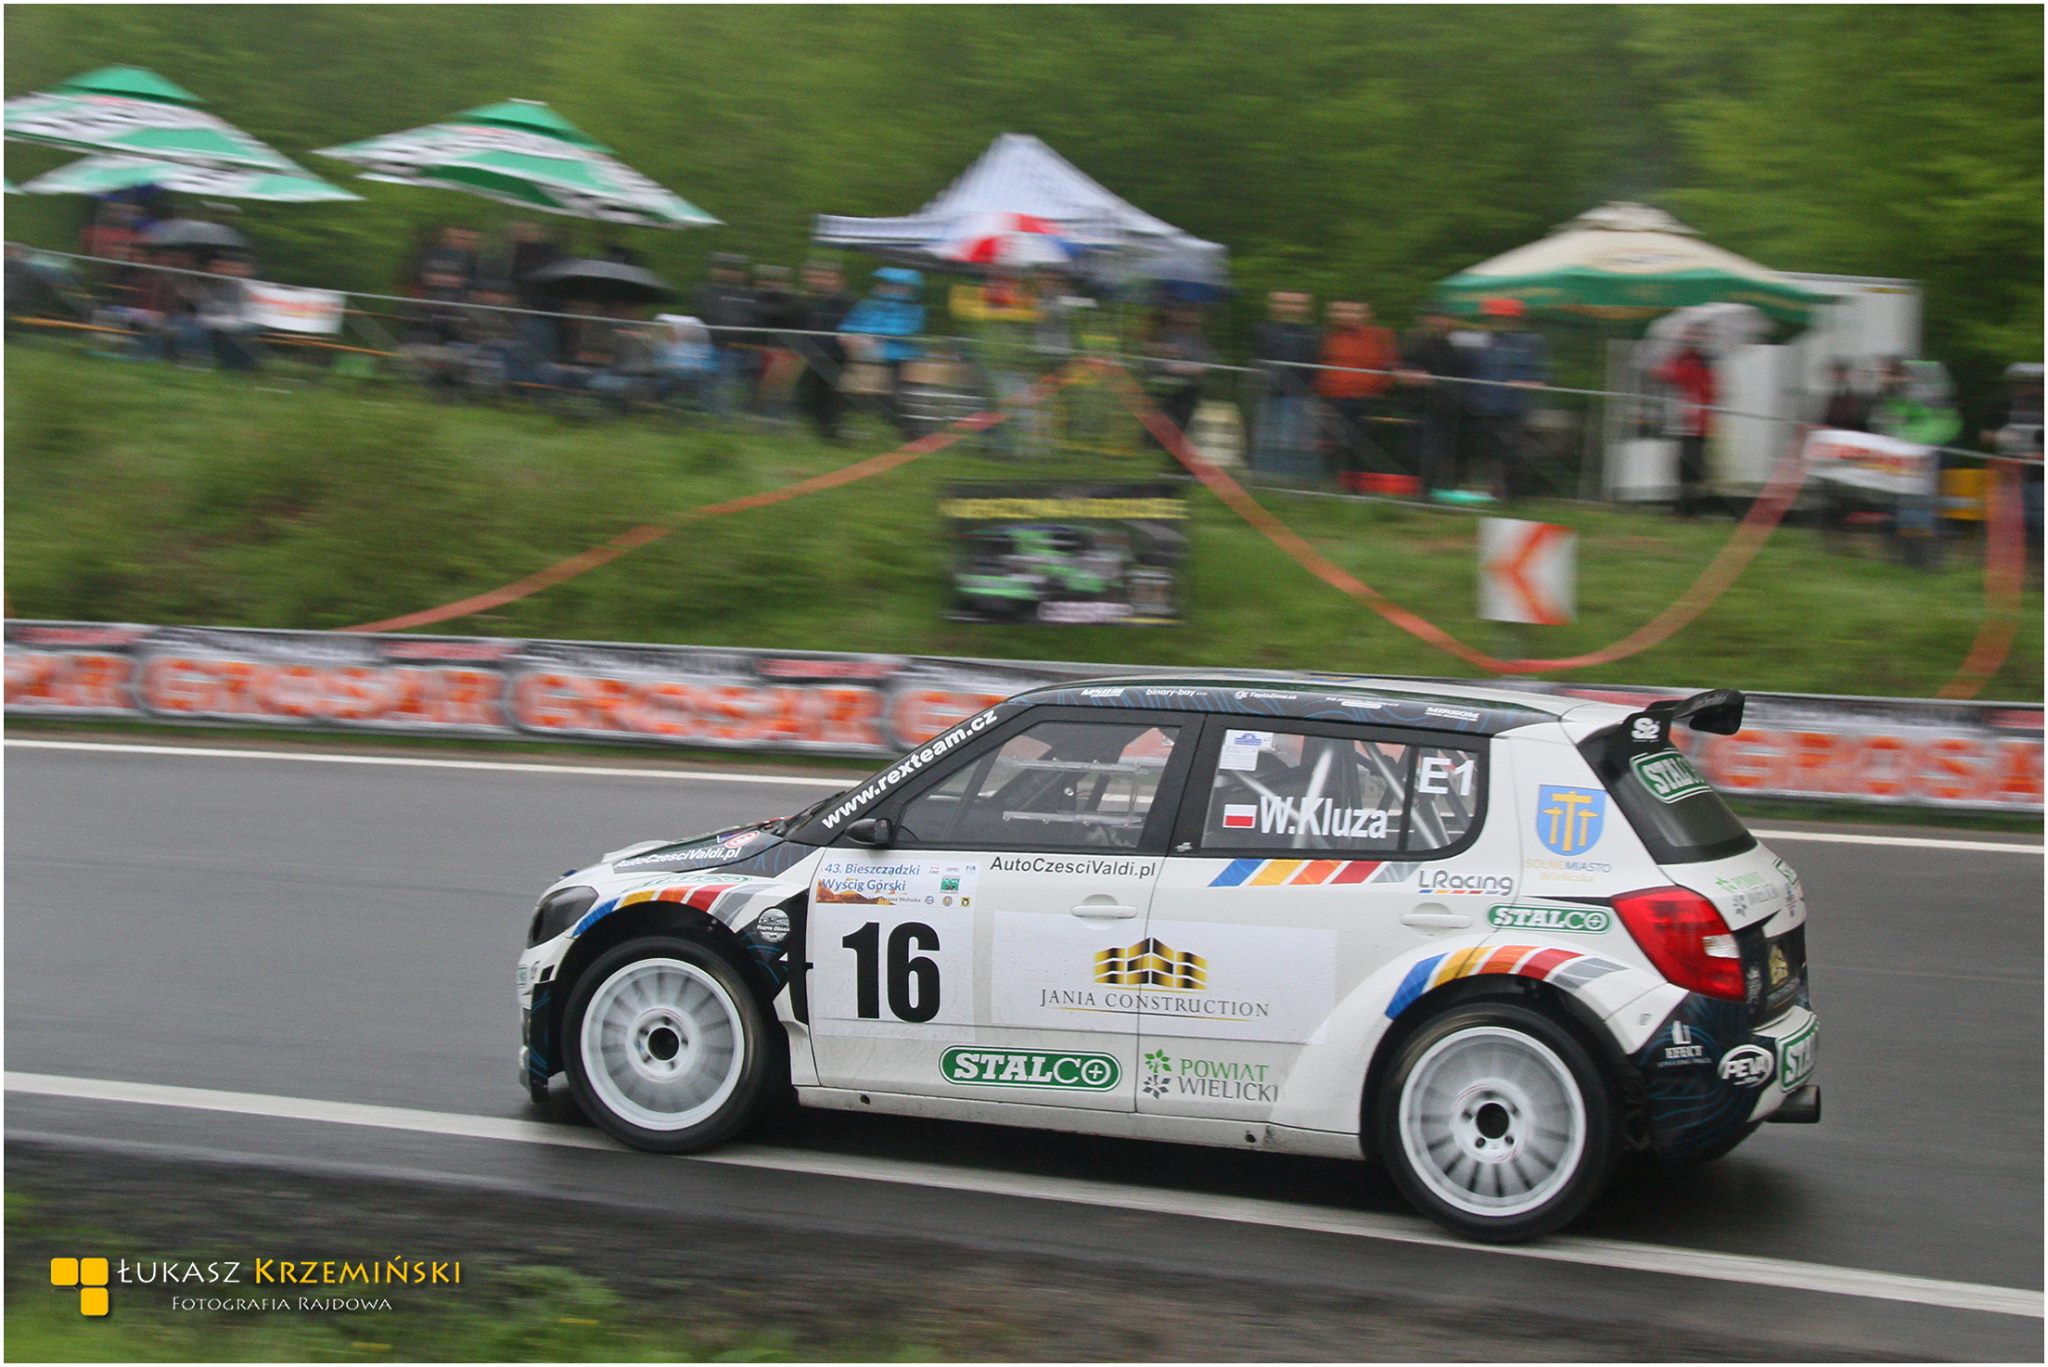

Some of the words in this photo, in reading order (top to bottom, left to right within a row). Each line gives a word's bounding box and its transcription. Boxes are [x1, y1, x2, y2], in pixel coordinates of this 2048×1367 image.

[821, 709, 999, 830] www.rexteam.cz
[1418, 756, 1475, 797] E1
[1260, 794, 1389, 839] W.Kluza
[990, 856, 1156, 879] AutoCzesciValdi.pl
[867, 879, 906, 892] Górski
[1493, 907, 1608, 931] STALCO
[841, 921, 941, 1024] 16
[1040, 989, 1097, 1008] JANIA
[1104, 992, 1270, 1018] CONSTRUCTION
[953, 1052, 1112, 1086] STALCO
[1180, 1058, 1269, 1083] POWIAT
[1178, 1076, 1279, 1103] WIELICKI
